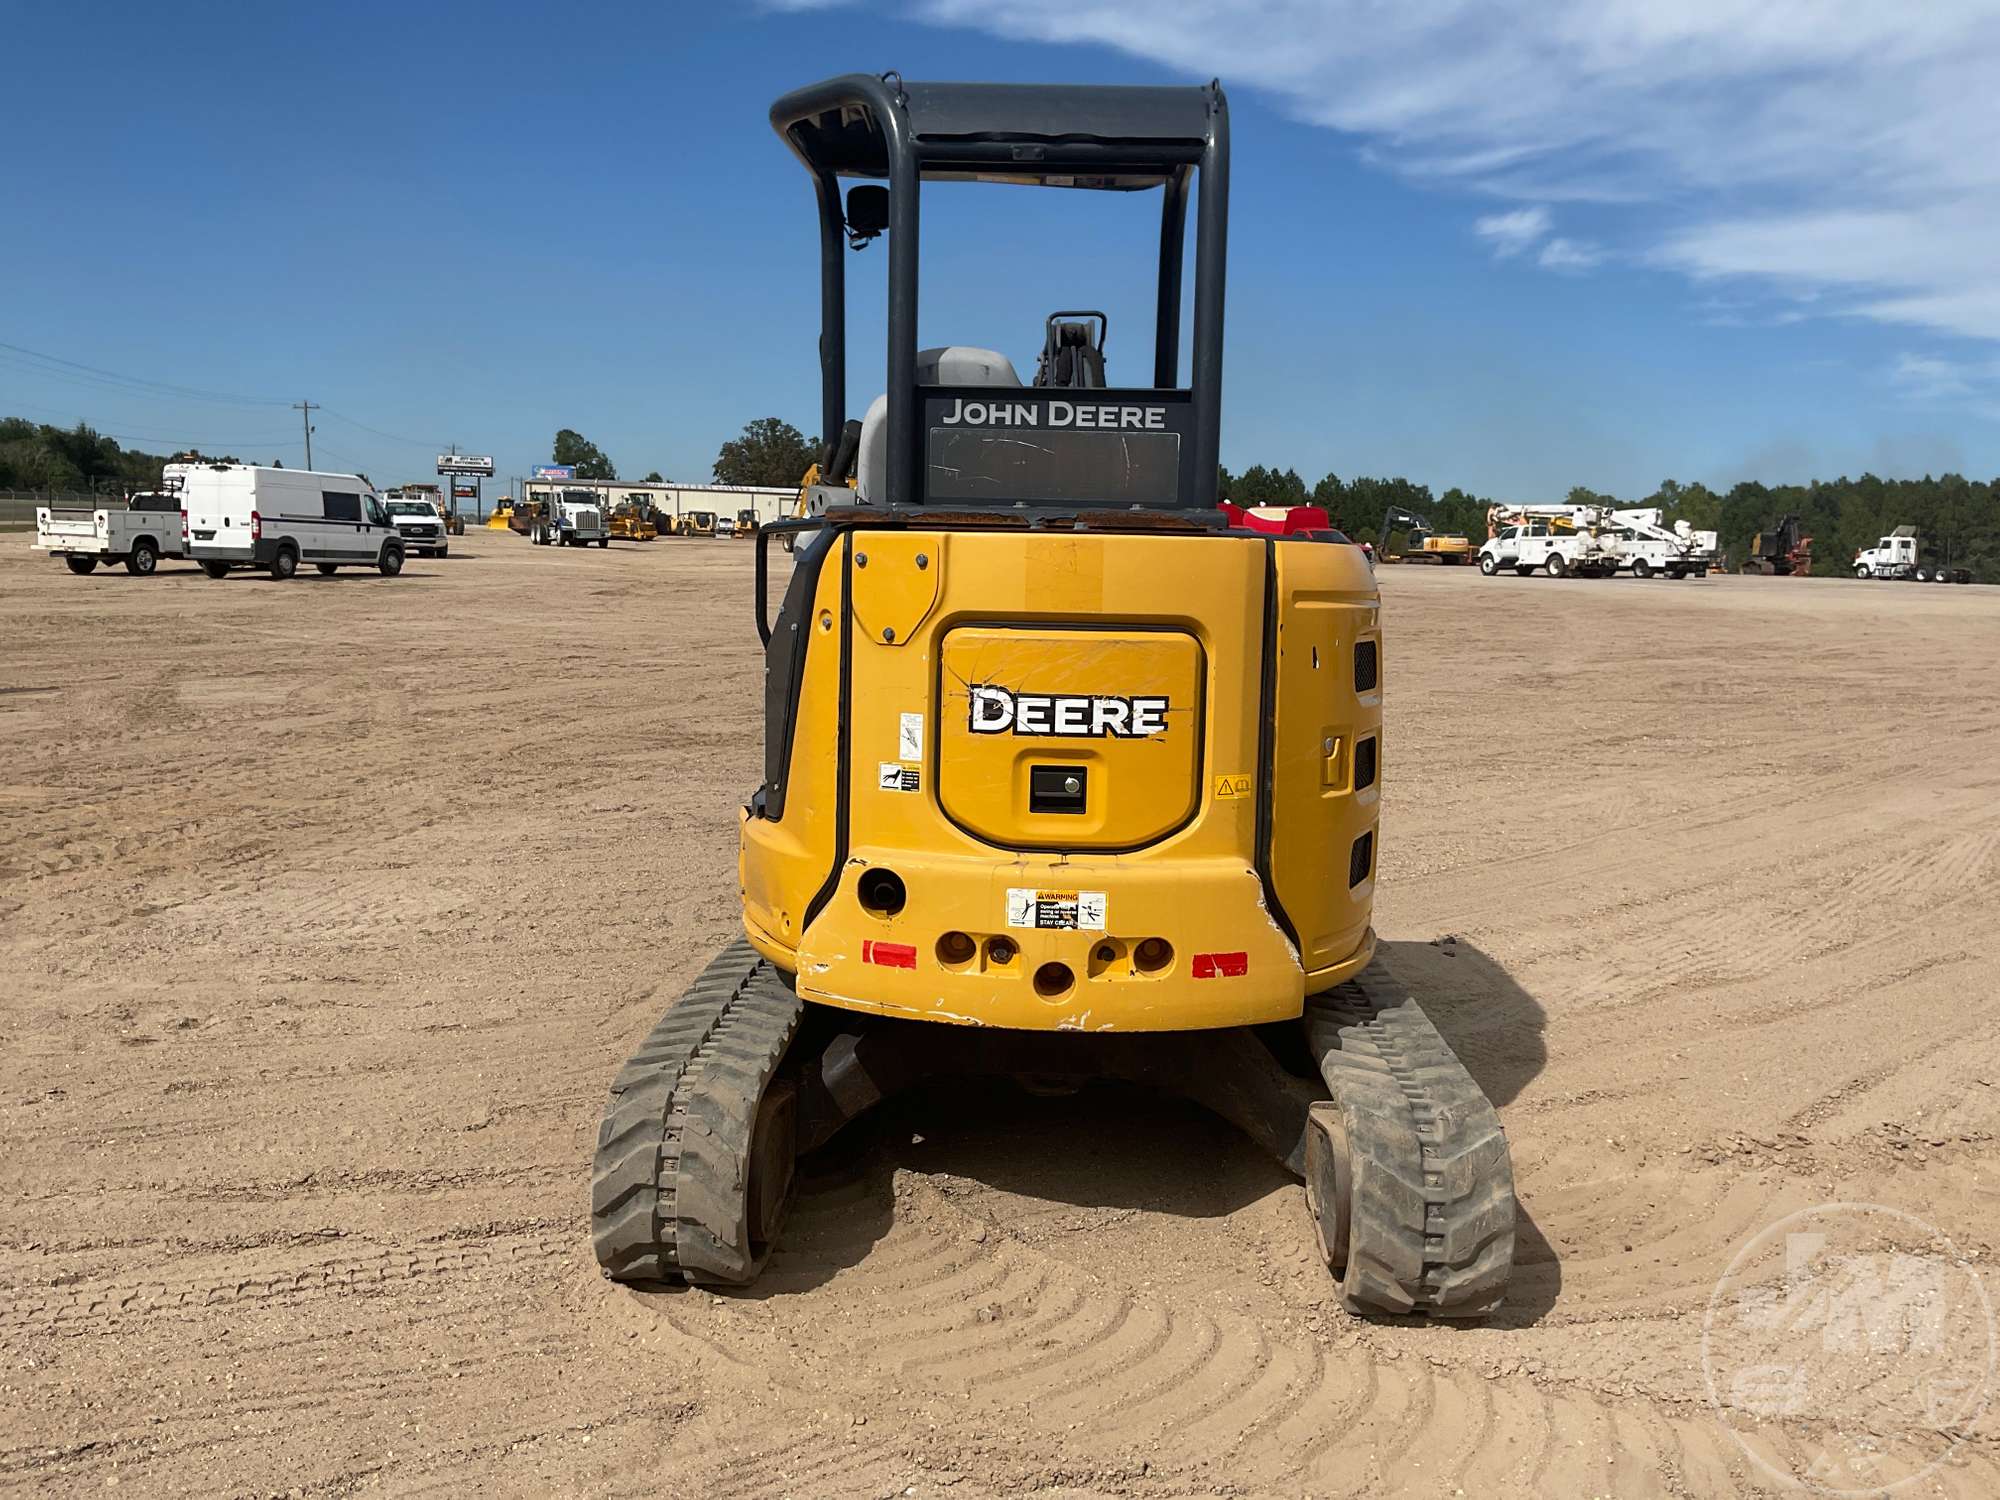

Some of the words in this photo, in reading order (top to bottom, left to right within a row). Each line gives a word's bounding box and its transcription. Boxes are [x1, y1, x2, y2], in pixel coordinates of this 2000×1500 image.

[943, 398, 1037, 426] JOHN
[1048, 400, 1166, 429] DEERE
[970, 685, 1169, 736] DEERE
[1044, 893, 1078, 901] WARNING
